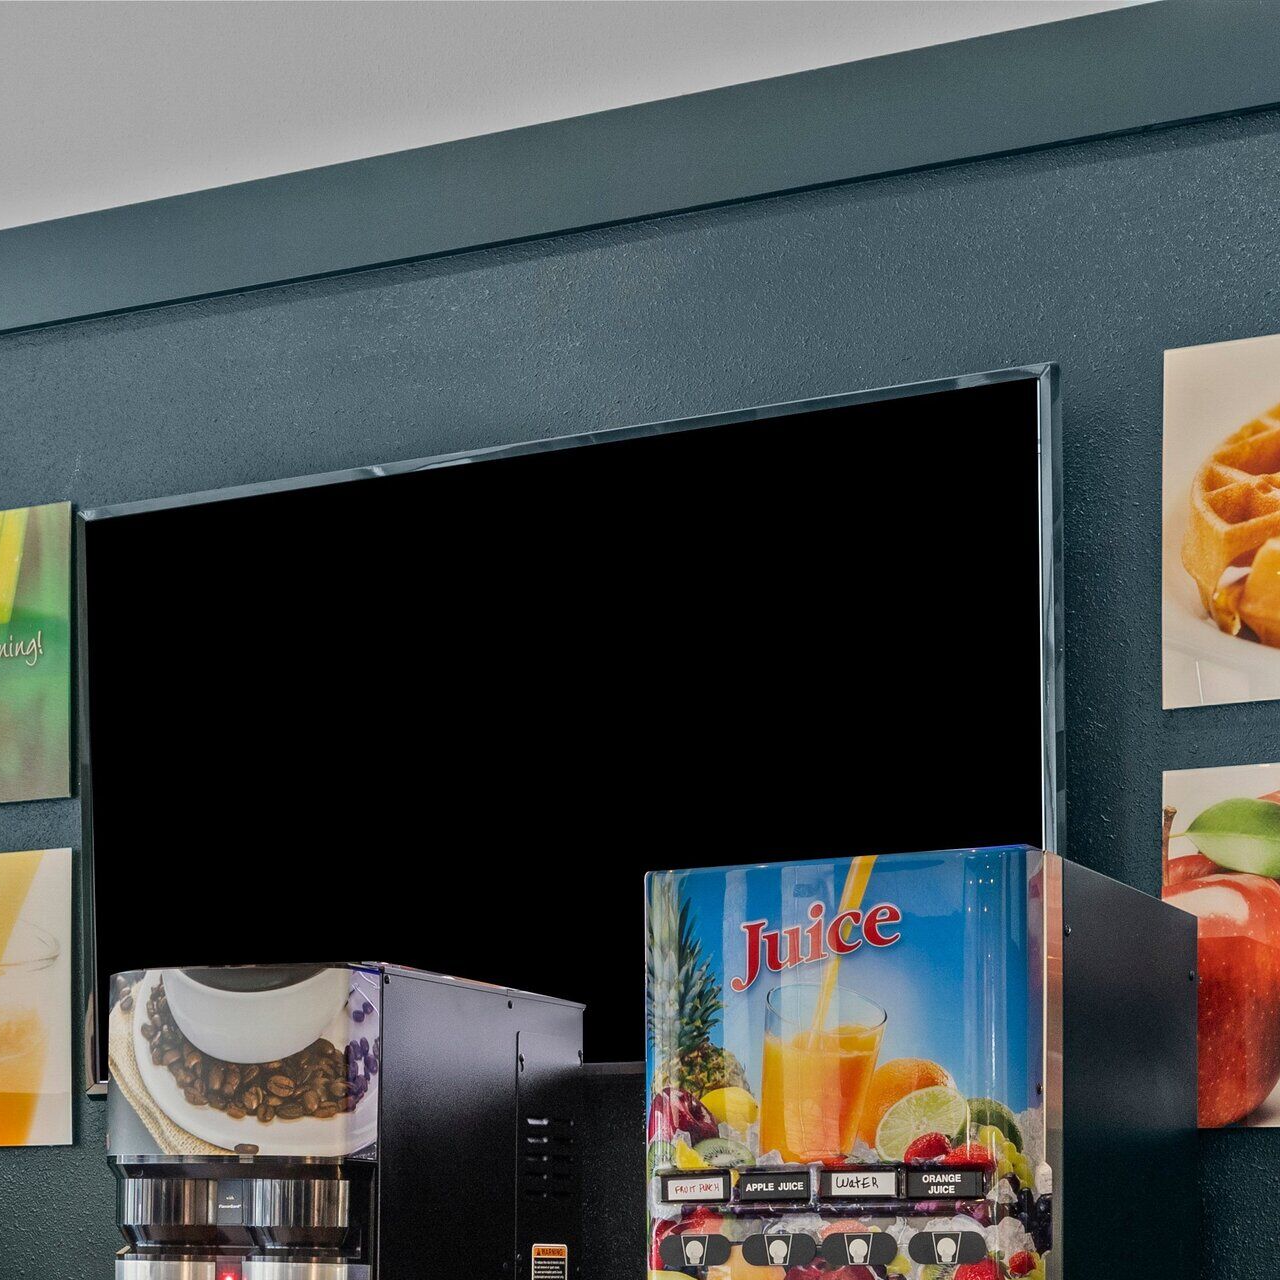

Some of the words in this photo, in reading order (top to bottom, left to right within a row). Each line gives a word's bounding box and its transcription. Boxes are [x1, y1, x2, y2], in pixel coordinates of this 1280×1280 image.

[730, 900, 902, 993] Juice
[922, 1173, 961, 1183] ORANGE
[674, 1184, 695, 1194] FRUIT
[745, 1183, 774, 1192] APPLE
[778, 1181, 804, 1191] JUICE
[928, 1185, 955, 1194] JUICE
